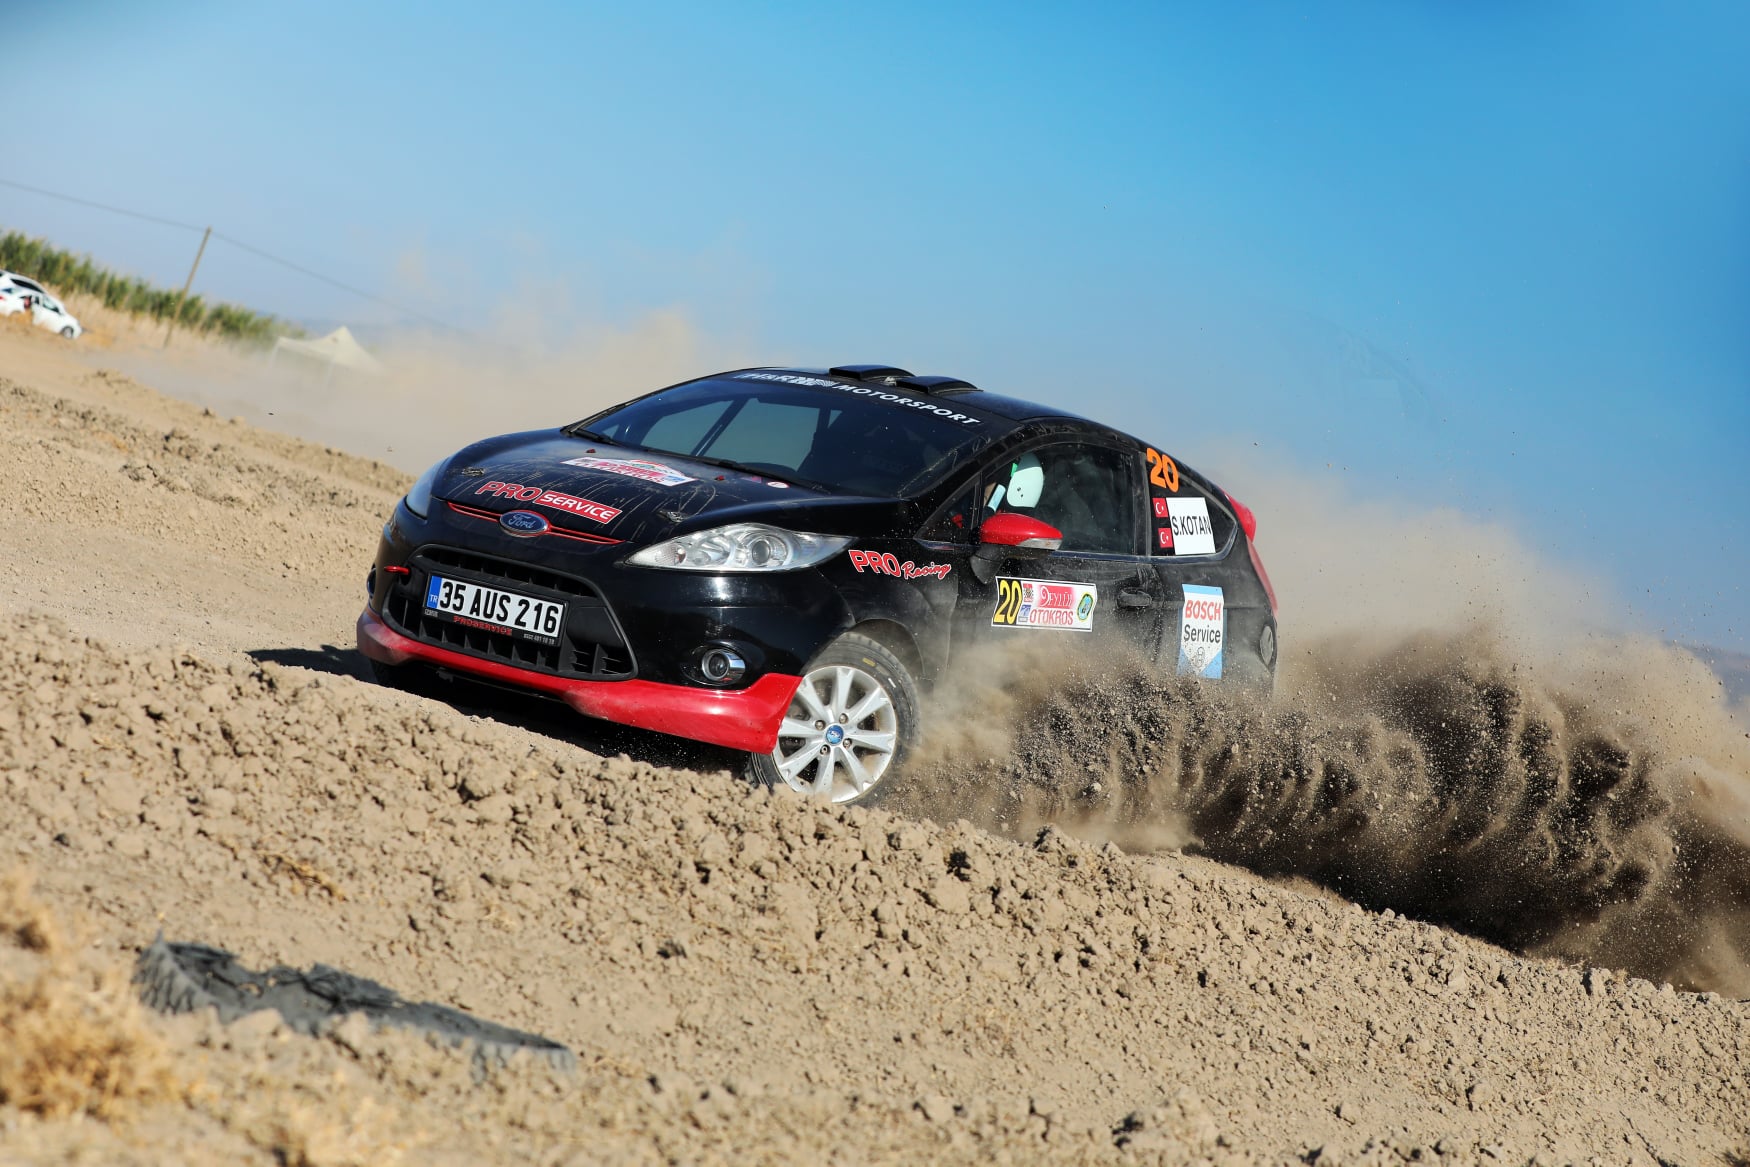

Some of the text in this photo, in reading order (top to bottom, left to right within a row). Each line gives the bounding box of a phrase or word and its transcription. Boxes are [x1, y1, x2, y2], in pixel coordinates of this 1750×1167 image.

[833, 384, 982, 425] MOTORSPORT
[1147, 447, 1179, 493] 20
[475, 481, 616, 521] PRO SERVICE
[508, 514, 537, 529] Ford
[1171, 515, 1213, 536] S.KOTAN
[848, 549, 952, 580] PRO Racing
[429, 594, 438, 603] TR
[439, 581, 559, 634] 35 AUS 216
[993, 579, 1023, 625] 20
[1185, 600, 1222, 621] BOSCH
[1029, 609, 1074, 626] OTOKROS
[1184, 624, 1221, 644] Service
